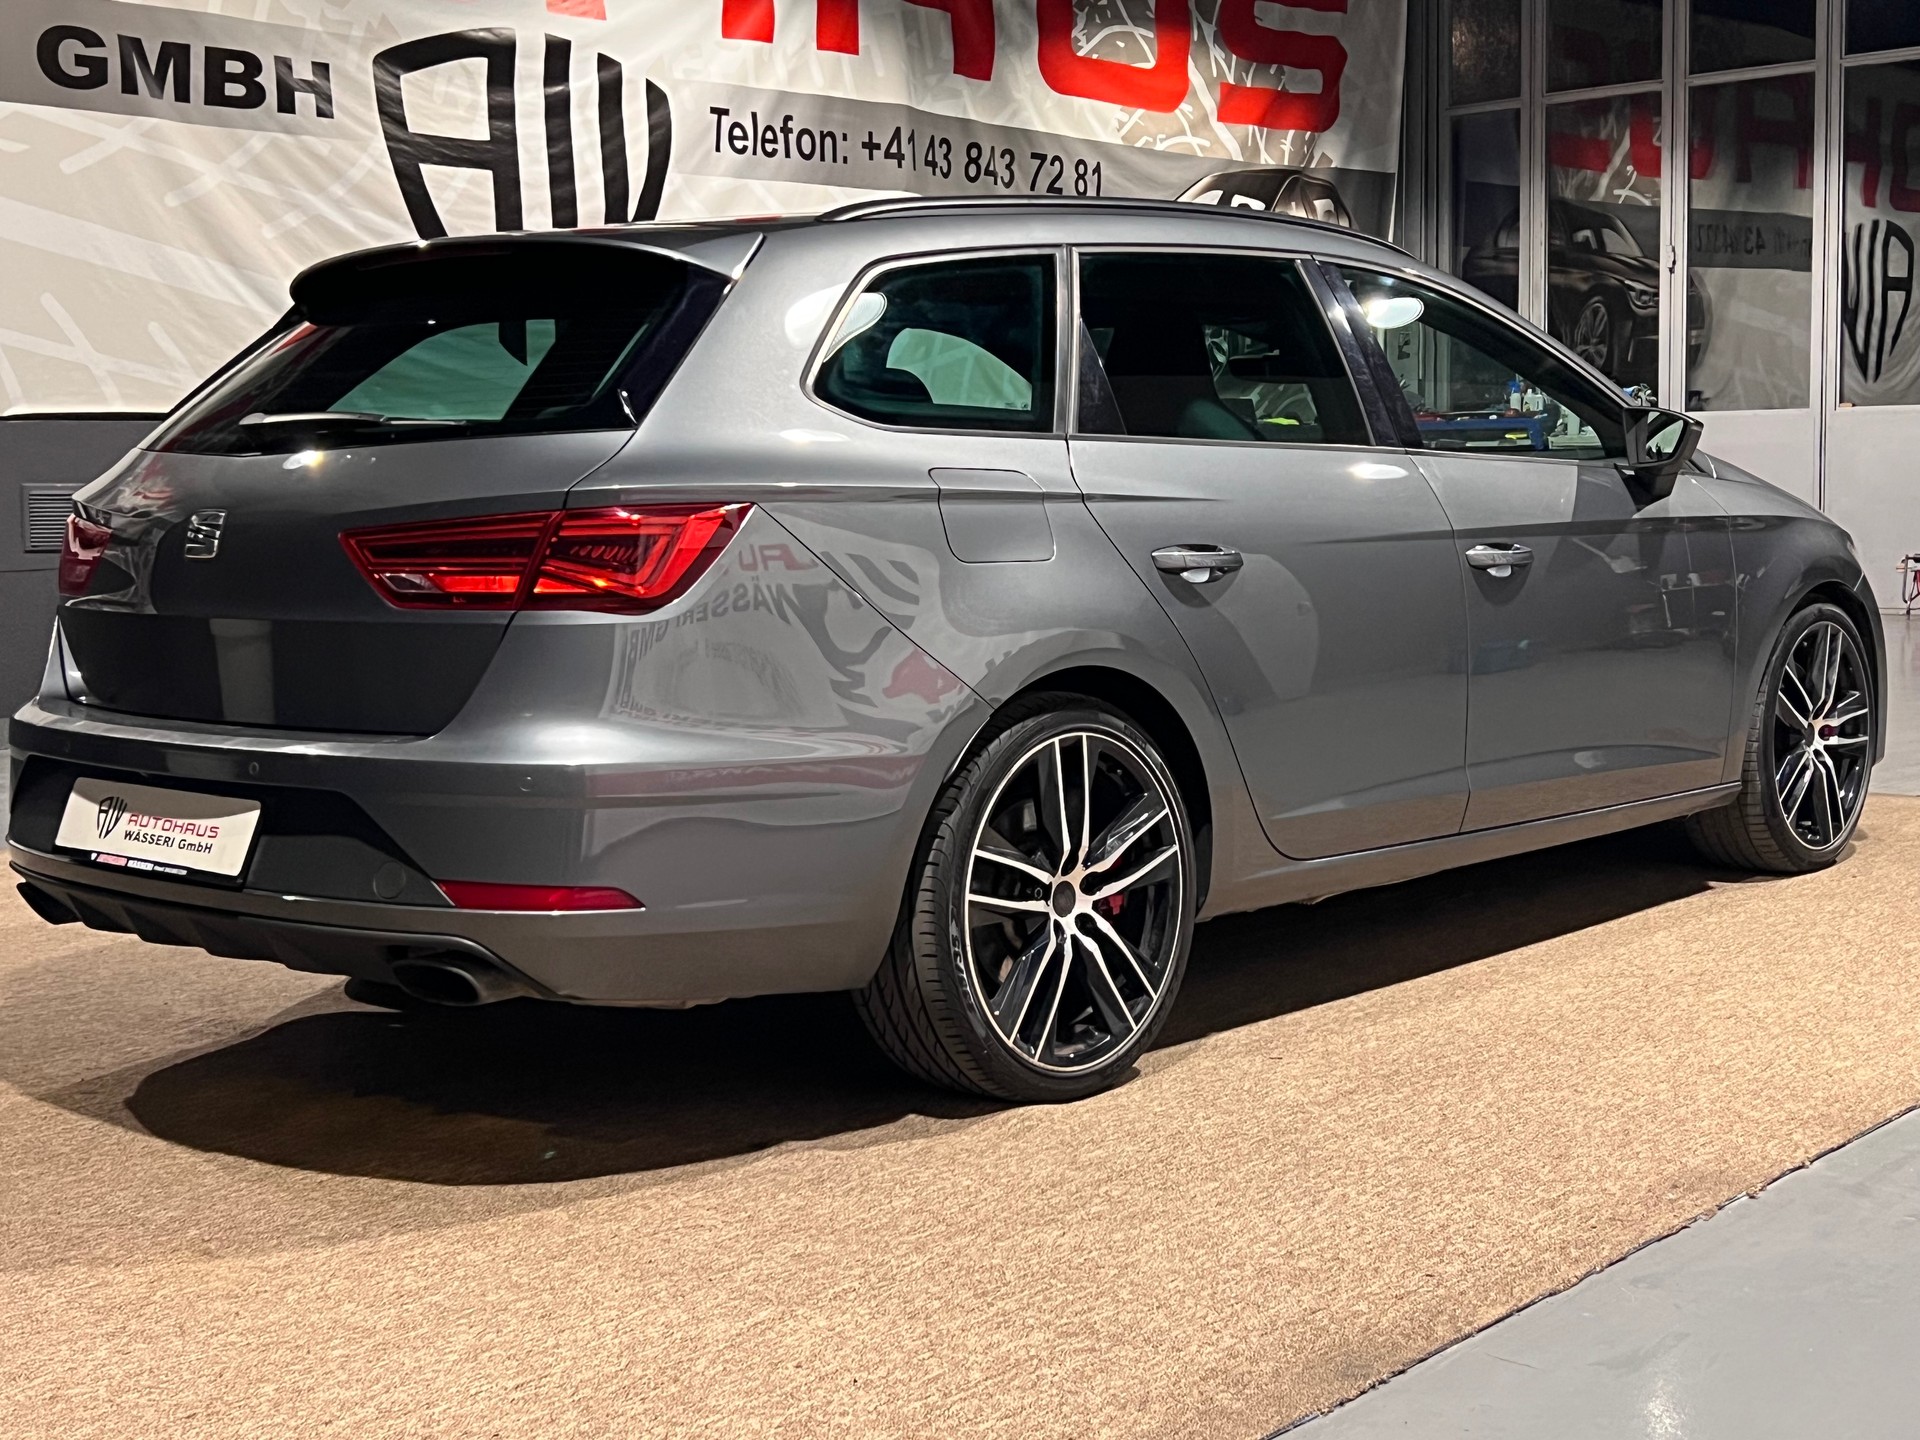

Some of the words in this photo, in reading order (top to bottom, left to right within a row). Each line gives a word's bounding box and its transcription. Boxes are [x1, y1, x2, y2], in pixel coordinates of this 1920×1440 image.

[36, 24, 335, 119] GMBH
[708, 105, 849, 164] Telefon:
[963, 141, 1016, 190] 843
[1029, 151, 1065, 195] 72
[1073, 158, 1103, 197] 81
[123, 829, 176, 848] WÄSSERI
[177, 838, 213, 854] GmbH
[127, 813, 220, 839] AUTOHAUS
